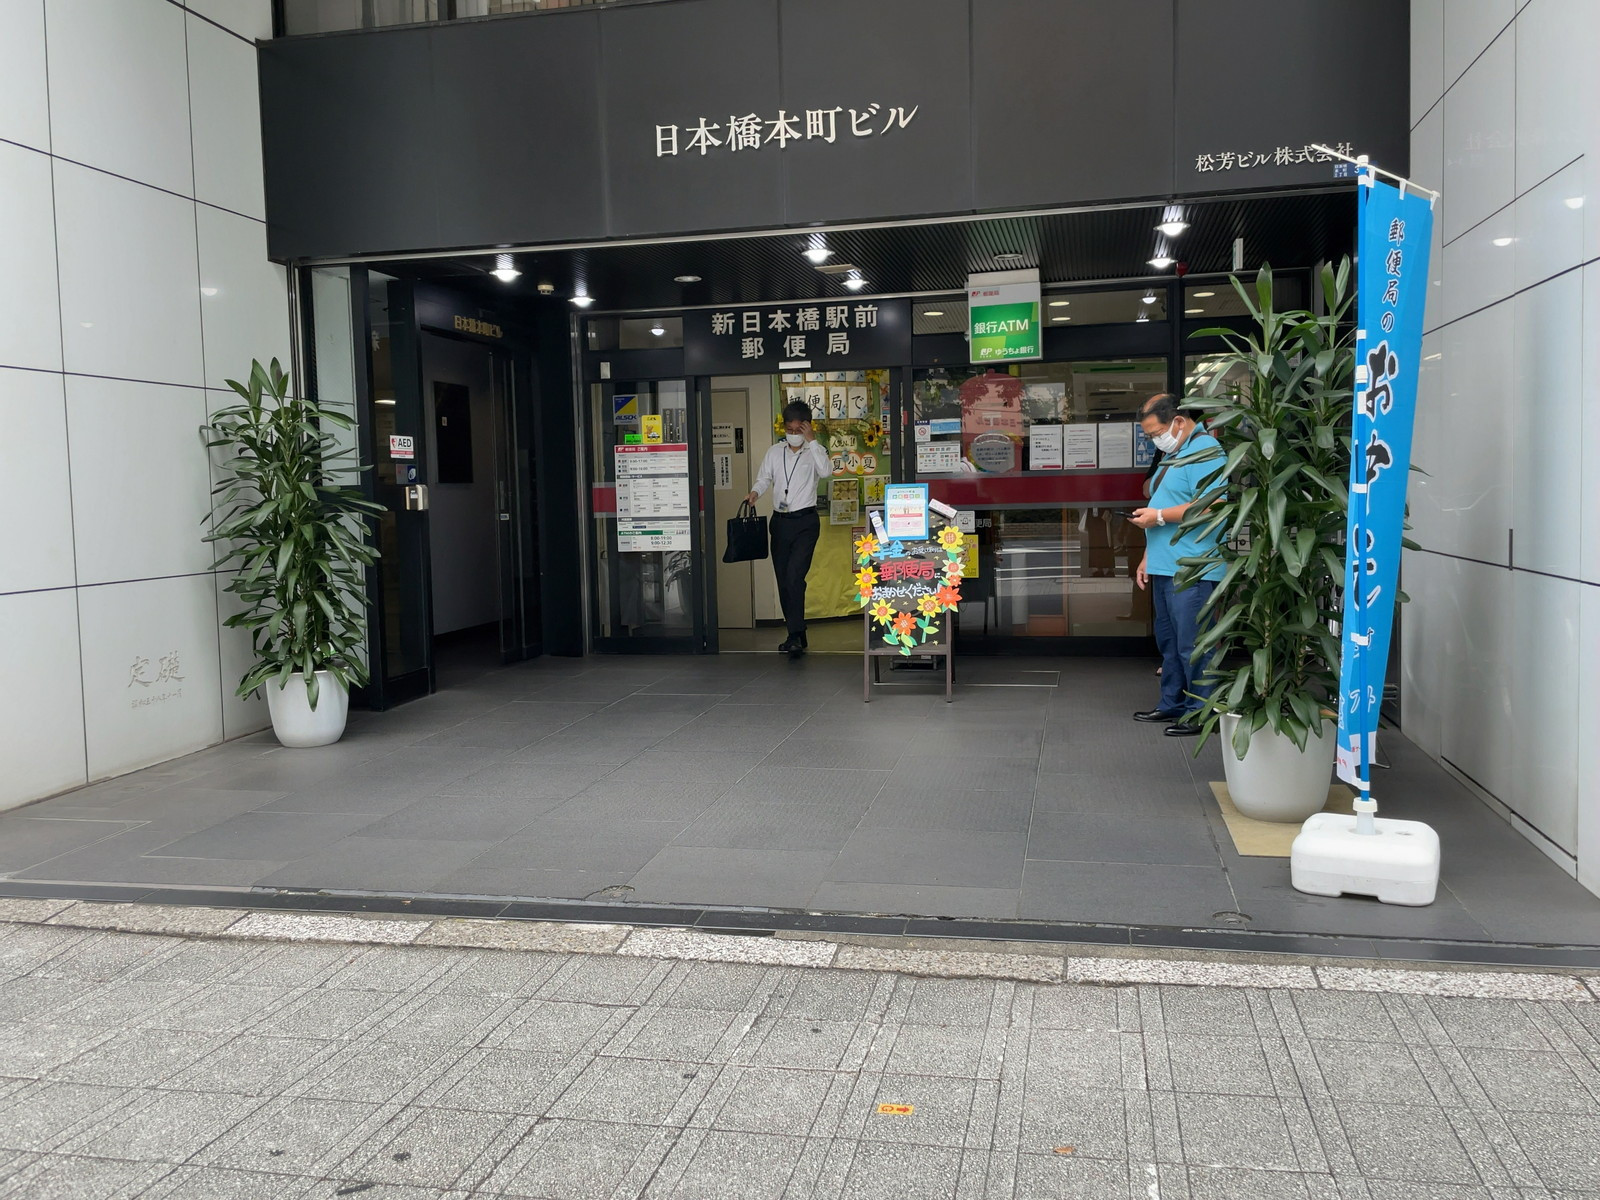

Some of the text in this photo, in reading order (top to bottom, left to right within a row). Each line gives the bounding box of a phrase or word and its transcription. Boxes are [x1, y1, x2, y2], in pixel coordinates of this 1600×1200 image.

[655, 104, 919, 157] 日本橋本町ビル
[1194, 142, 1354, 173] 松芳ビル株式会社
[1381, 217, 1405, 333] 郵便局の
[711, 304, 879, 336] 新日本橋駅前
[974, 319, 1029, 335] 銀行ATM
[741, 332, 850, 360] 郵便局
[995, 345, 1034, 356] ゆうちょ銀行
[398, 438, 412, 448] AED
[879, 560, 941, 581] 郵便局に
